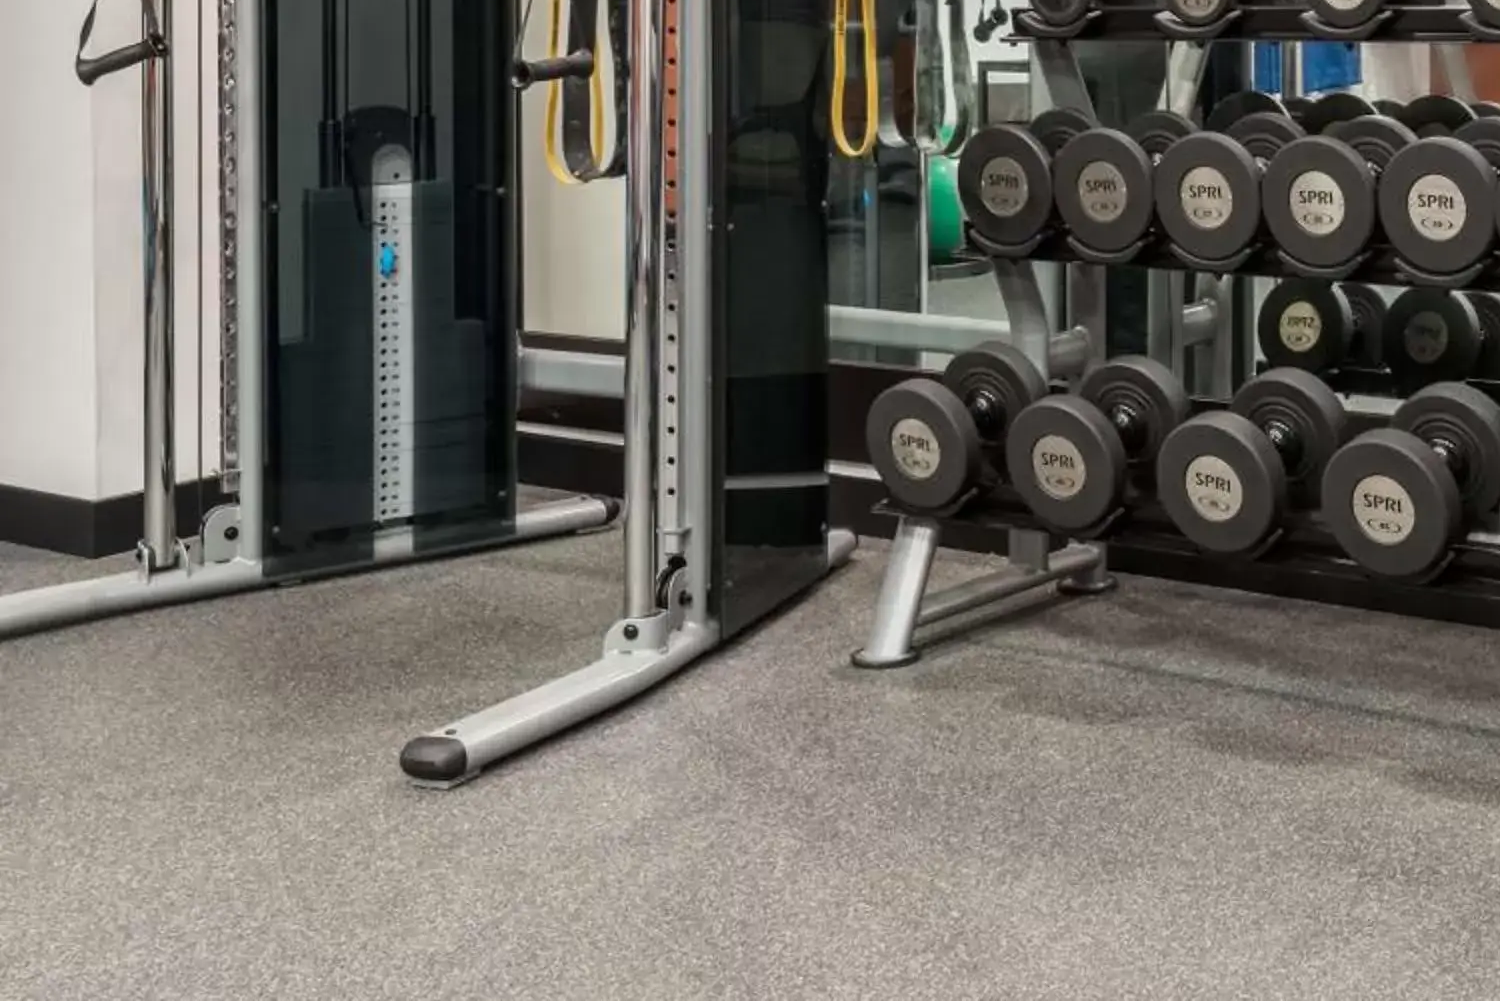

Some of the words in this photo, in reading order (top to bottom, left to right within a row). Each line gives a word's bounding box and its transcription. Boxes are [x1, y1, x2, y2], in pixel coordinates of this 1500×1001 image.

[1085, 179, 1117, 193] SPRI
[1189, 185, 1223, 200] SPRI
[1298, 190, 1333, 205] SPRI
[1417, 194, 1454, 210] SPRI
[899, 433, 930, 452] SPRI
[1041, 452, 1075, 469] SPRI
[1195, 472, 1231, 493] SPRI
[1362, 493, 1402, 513] SPRI
